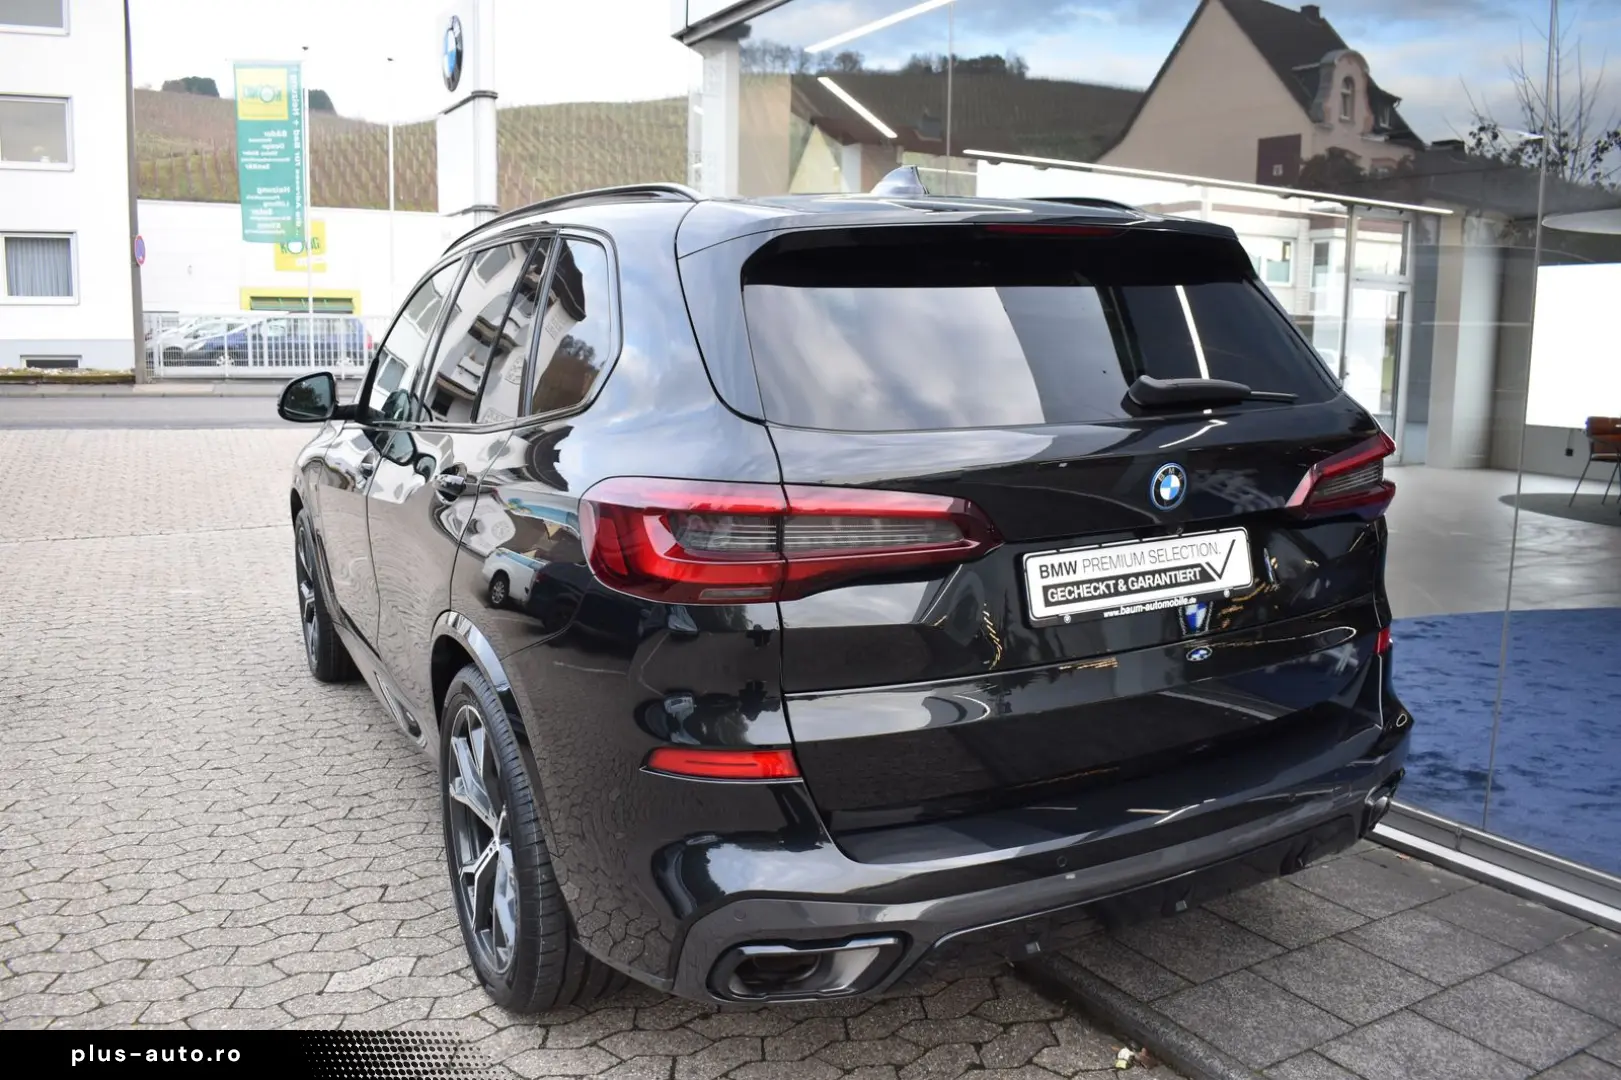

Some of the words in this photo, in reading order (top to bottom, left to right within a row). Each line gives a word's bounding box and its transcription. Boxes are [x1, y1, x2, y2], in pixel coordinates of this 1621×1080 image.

[1158, 467, 1184, 481] BMW
[1039, 560, 1077, 579] BMW
[1082, 551, 1146, 573] PREMIUM
[1047, 580, 1116, 602] GECHECKT
[1118, 579, 1127, 592] &
[1128, 567, 1201, 590] GARANTIERT
[1103, 597, 1197, 618] www.baum-automobile.de
